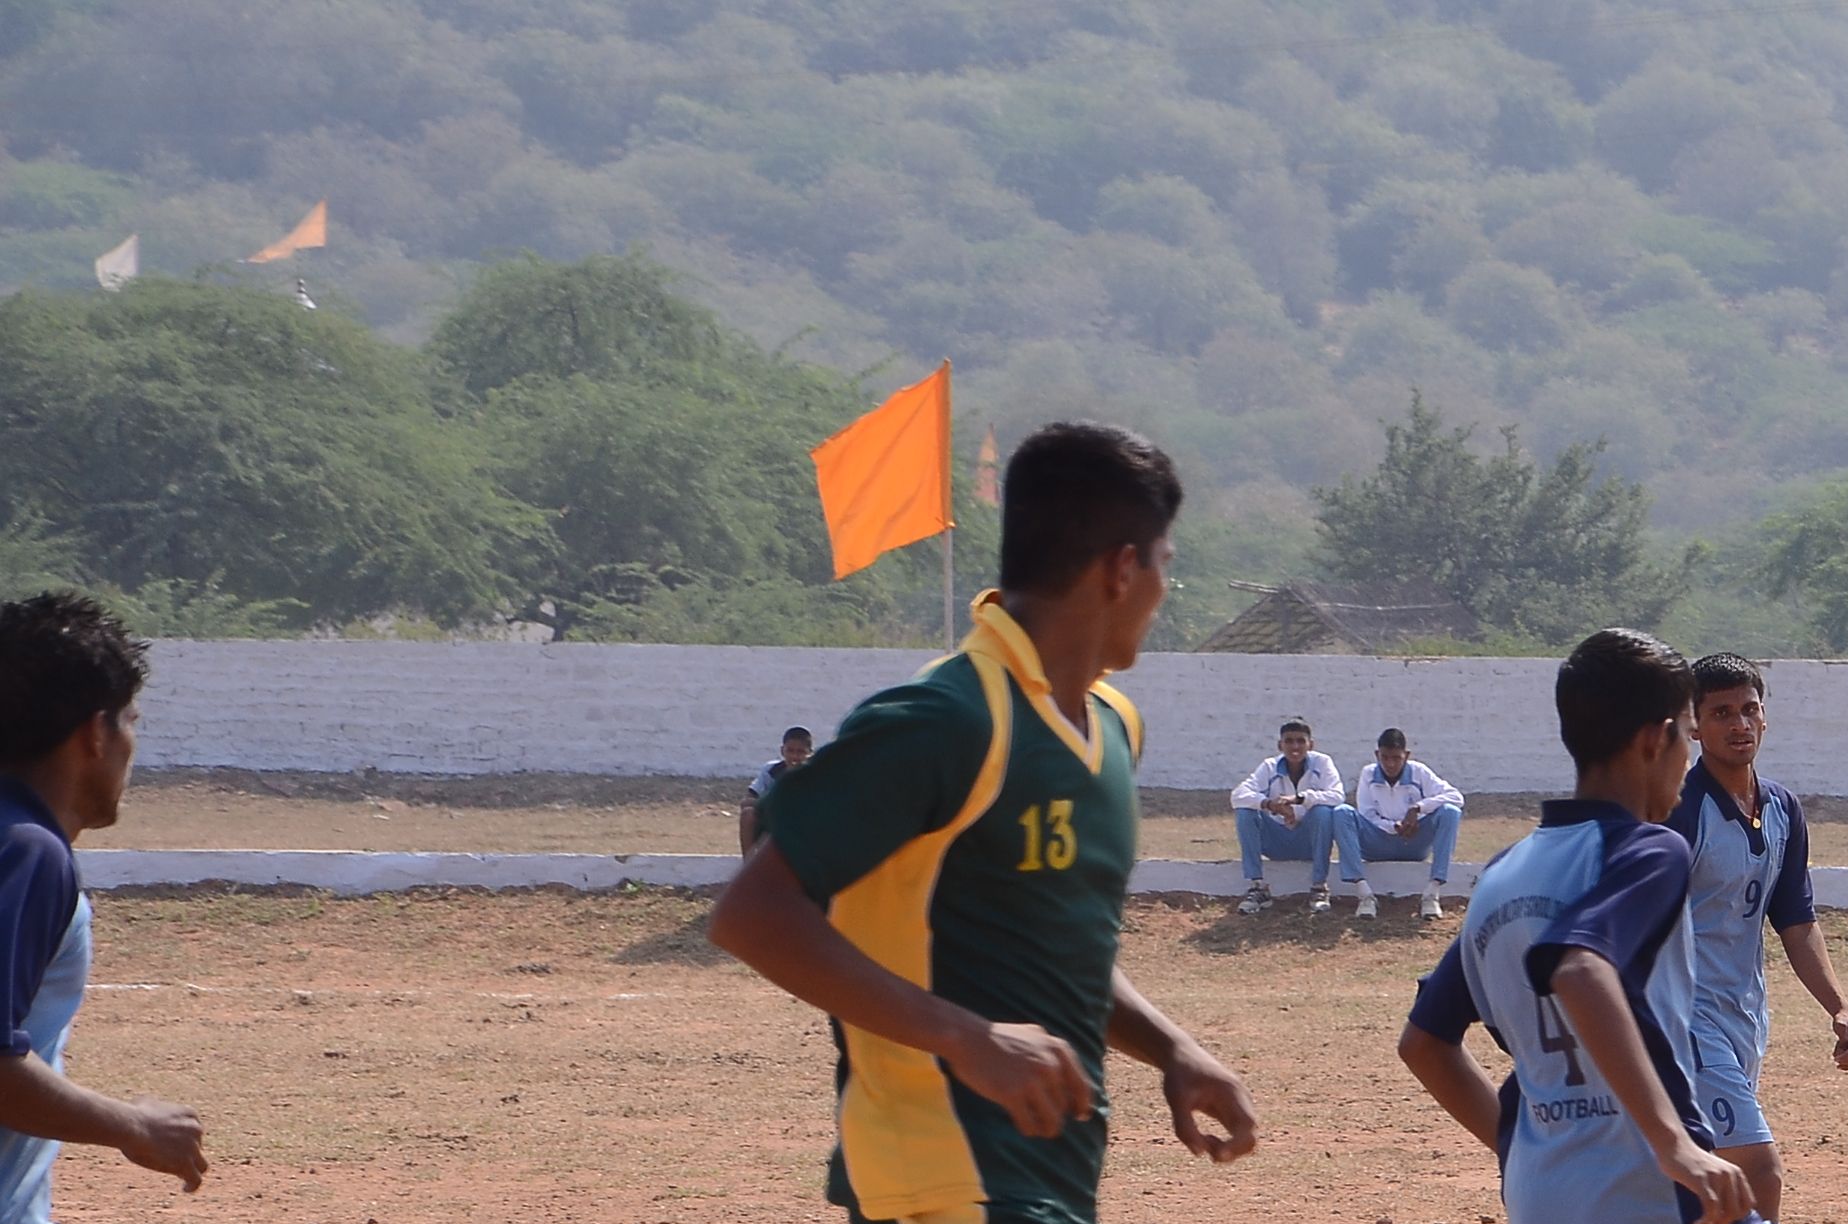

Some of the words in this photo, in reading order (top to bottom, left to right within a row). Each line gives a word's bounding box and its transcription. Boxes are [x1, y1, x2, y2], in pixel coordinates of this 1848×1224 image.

[1016, 799, 1077, 871] 13
[1742, 880, 1761, 918] 9
[1535, 992, 1586, 1086] 4
[1711, 1097, 1735, 1136] 9
